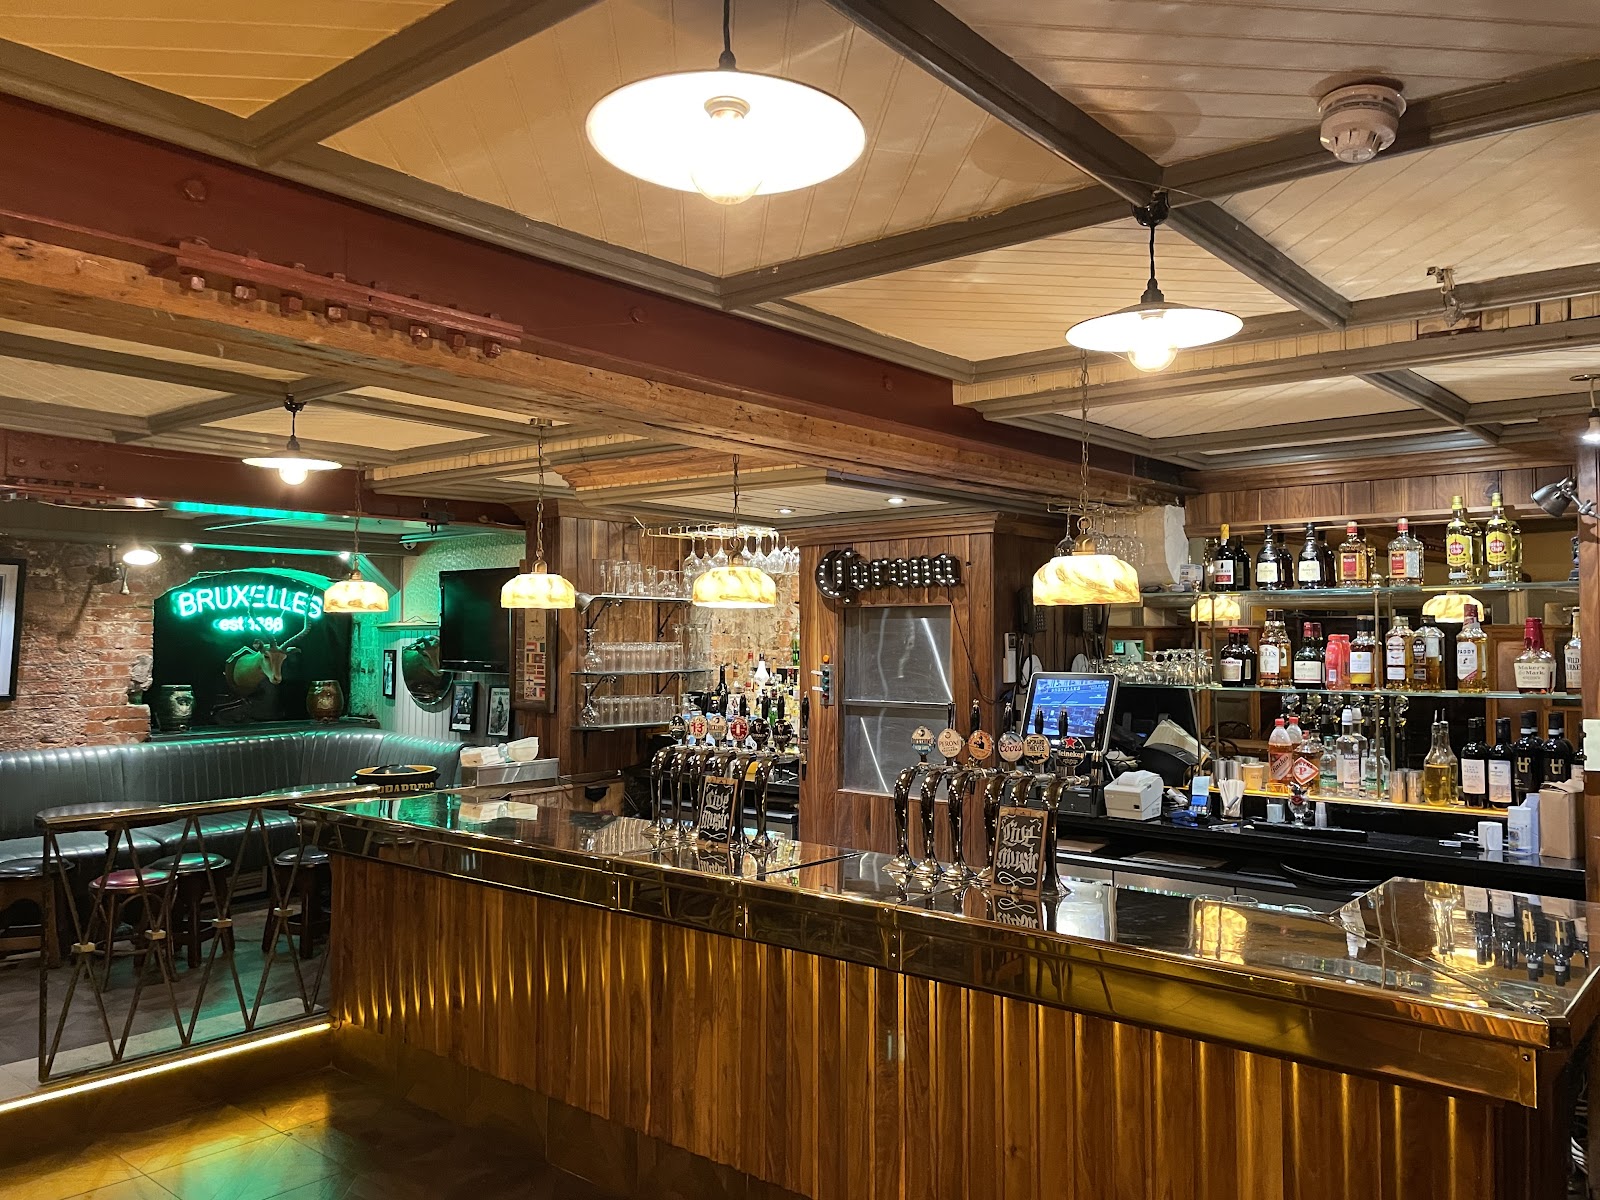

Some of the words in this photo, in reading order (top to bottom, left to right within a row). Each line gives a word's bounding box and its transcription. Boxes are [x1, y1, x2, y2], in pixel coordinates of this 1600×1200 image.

[178, 584, 323, 618] BRUXELLES
[219, 616, 244, 631] est
[691, 722, 704, 733] 13
[1000, 742, 1022, 753] Coors
[1299, 766, 1308, 775] P
[705, 788, 731, 811] Live
[1002, 819, 1041, 848] Live
